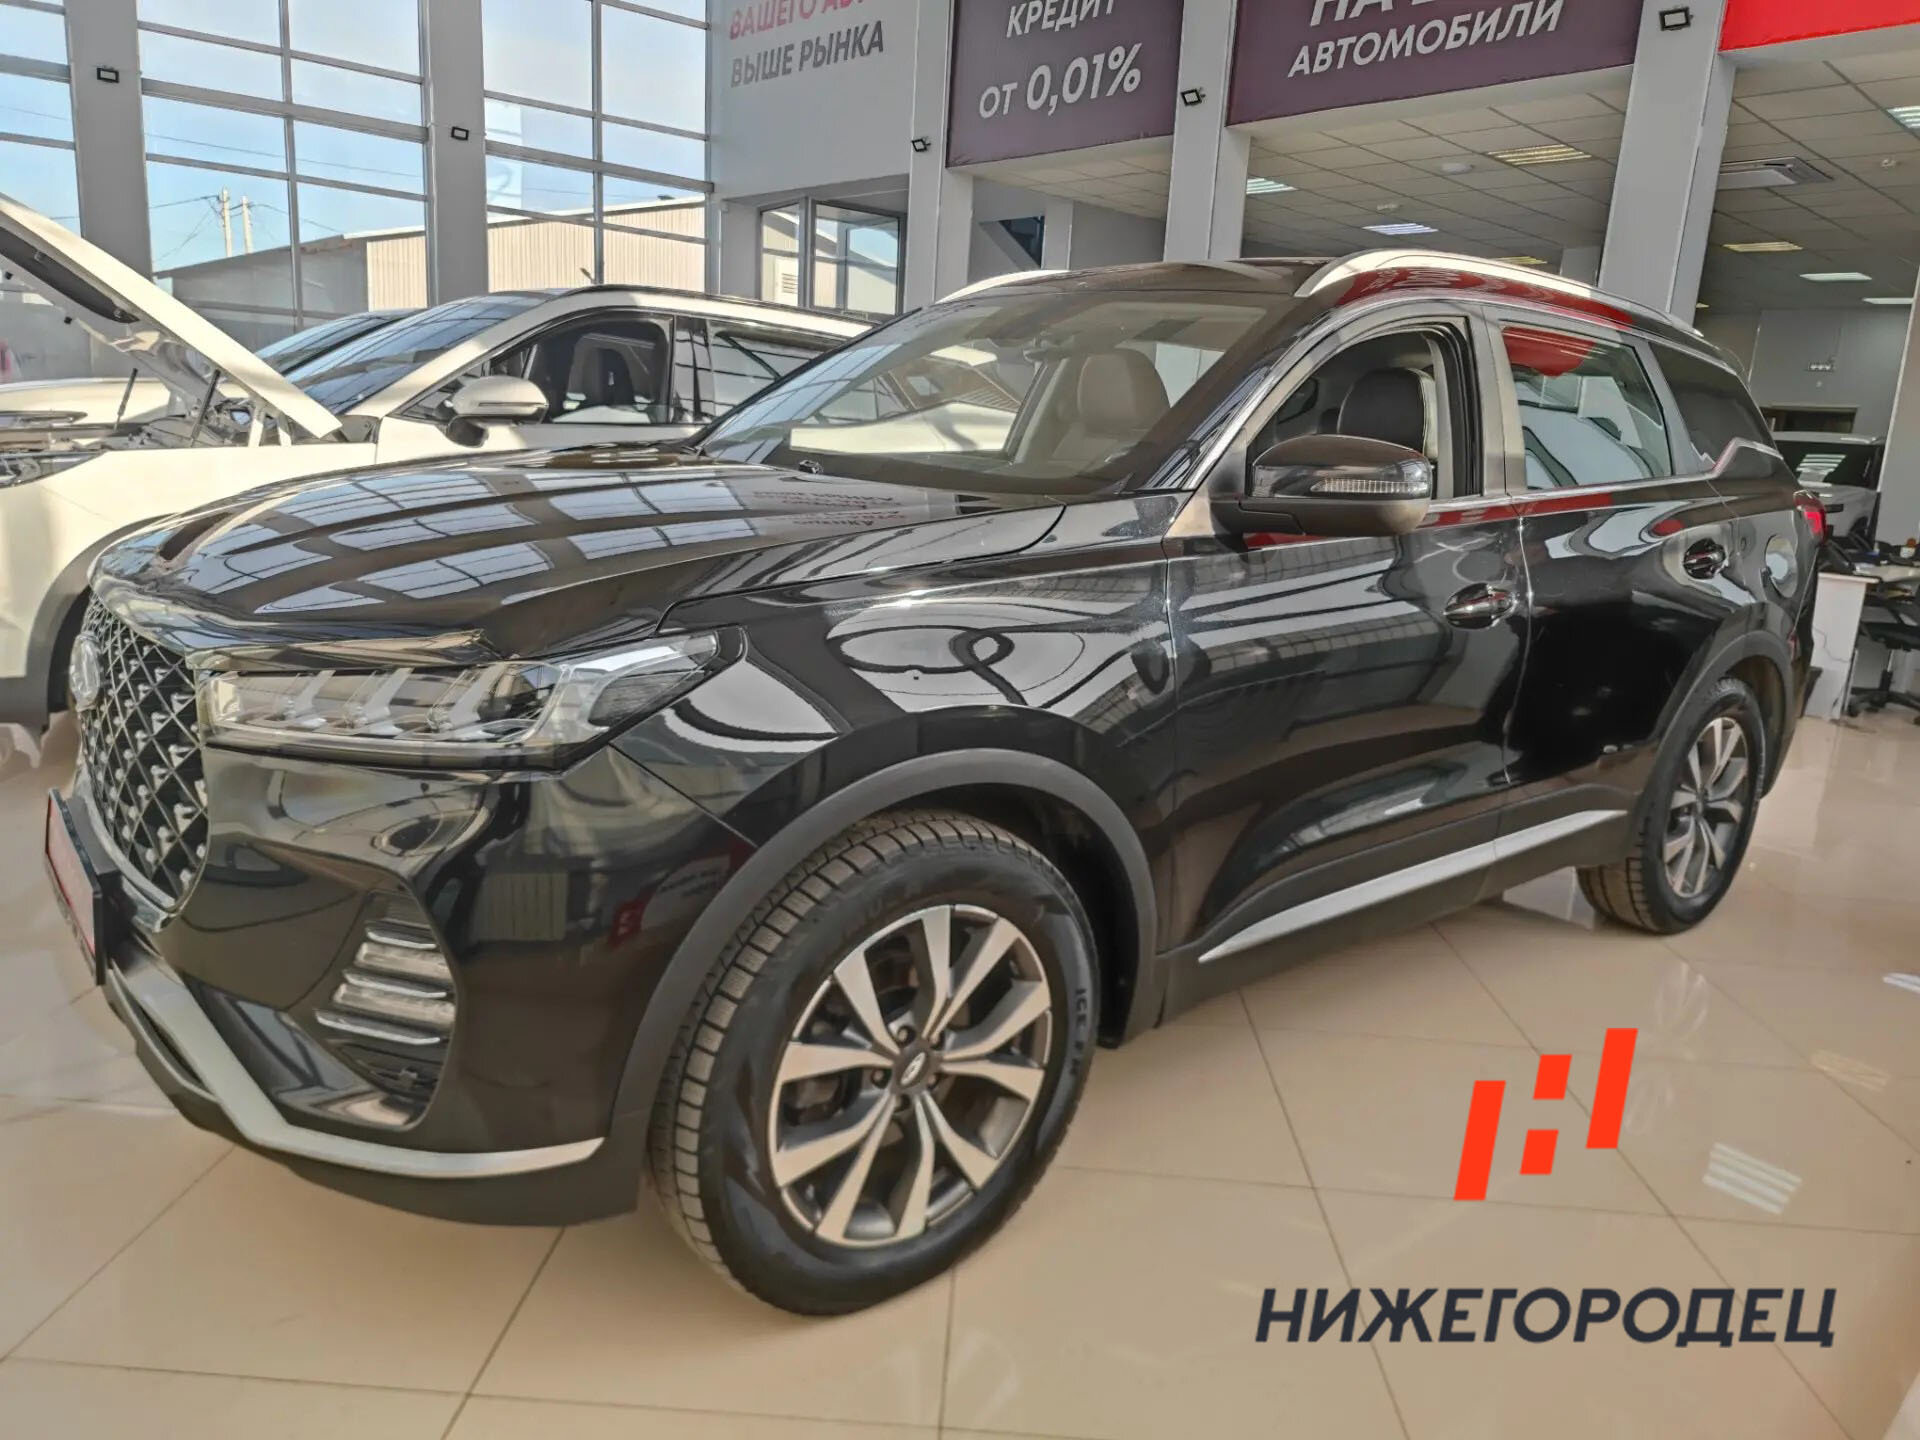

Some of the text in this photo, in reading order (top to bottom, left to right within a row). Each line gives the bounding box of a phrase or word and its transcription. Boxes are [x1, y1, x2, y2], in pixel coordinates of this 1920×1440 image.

[729, 0, 817, 40] ВАШЕГО
[730, 20, 884, 88] ВЫШЕ РЫНКА
[1287, 0, 1565, 78] АВТОМОБИЛИ
[1026, 42, 1143, 117] 0,01%
